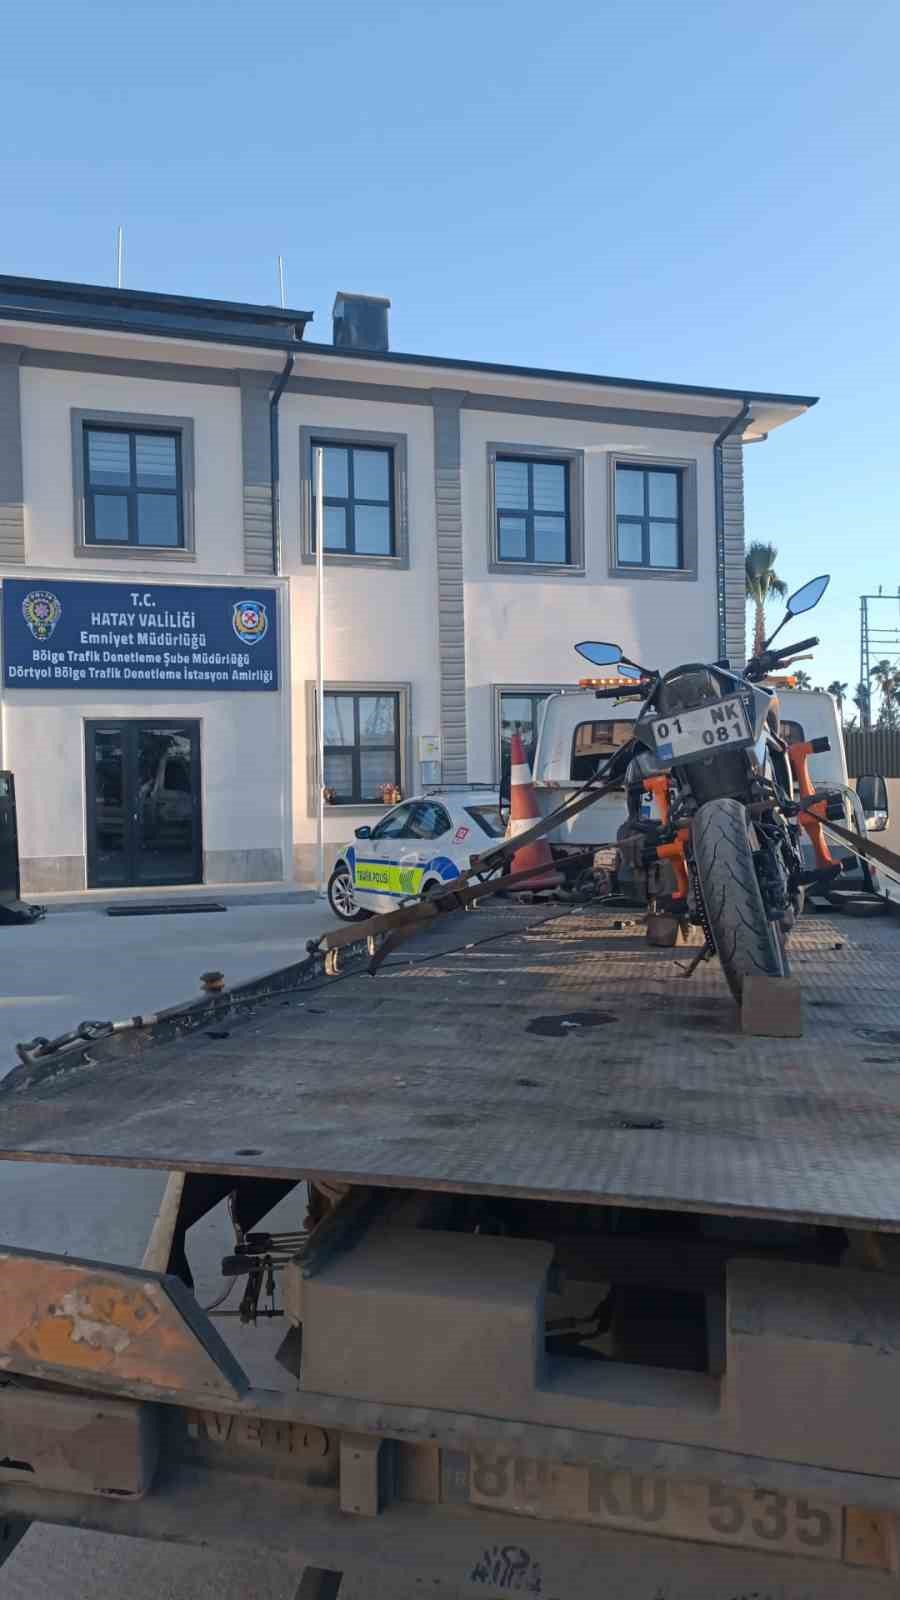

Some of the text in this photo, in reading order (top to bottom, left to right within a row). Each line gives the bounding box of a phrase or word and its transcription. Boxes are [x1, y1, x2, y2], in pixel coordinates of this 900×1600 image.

[130, 593, 156, 607] T.C.
[91, 611, 195, 628] HATAY VALİLİĞİ
[80, 632, 207, 649] Emniyet Müdürlüğü
[32, 651, 250, 666] Bölge Trafik Denetleme Şube Müdürlüğü
[8, 666, 273, 684] Dörtyol Bölge Trafik Denetleme İstasyon Amirliği
[657, 704, 738, 738] 01 NK
[702, 723, 742, 745] 081
[706, 1480, 834, 1547] 535
